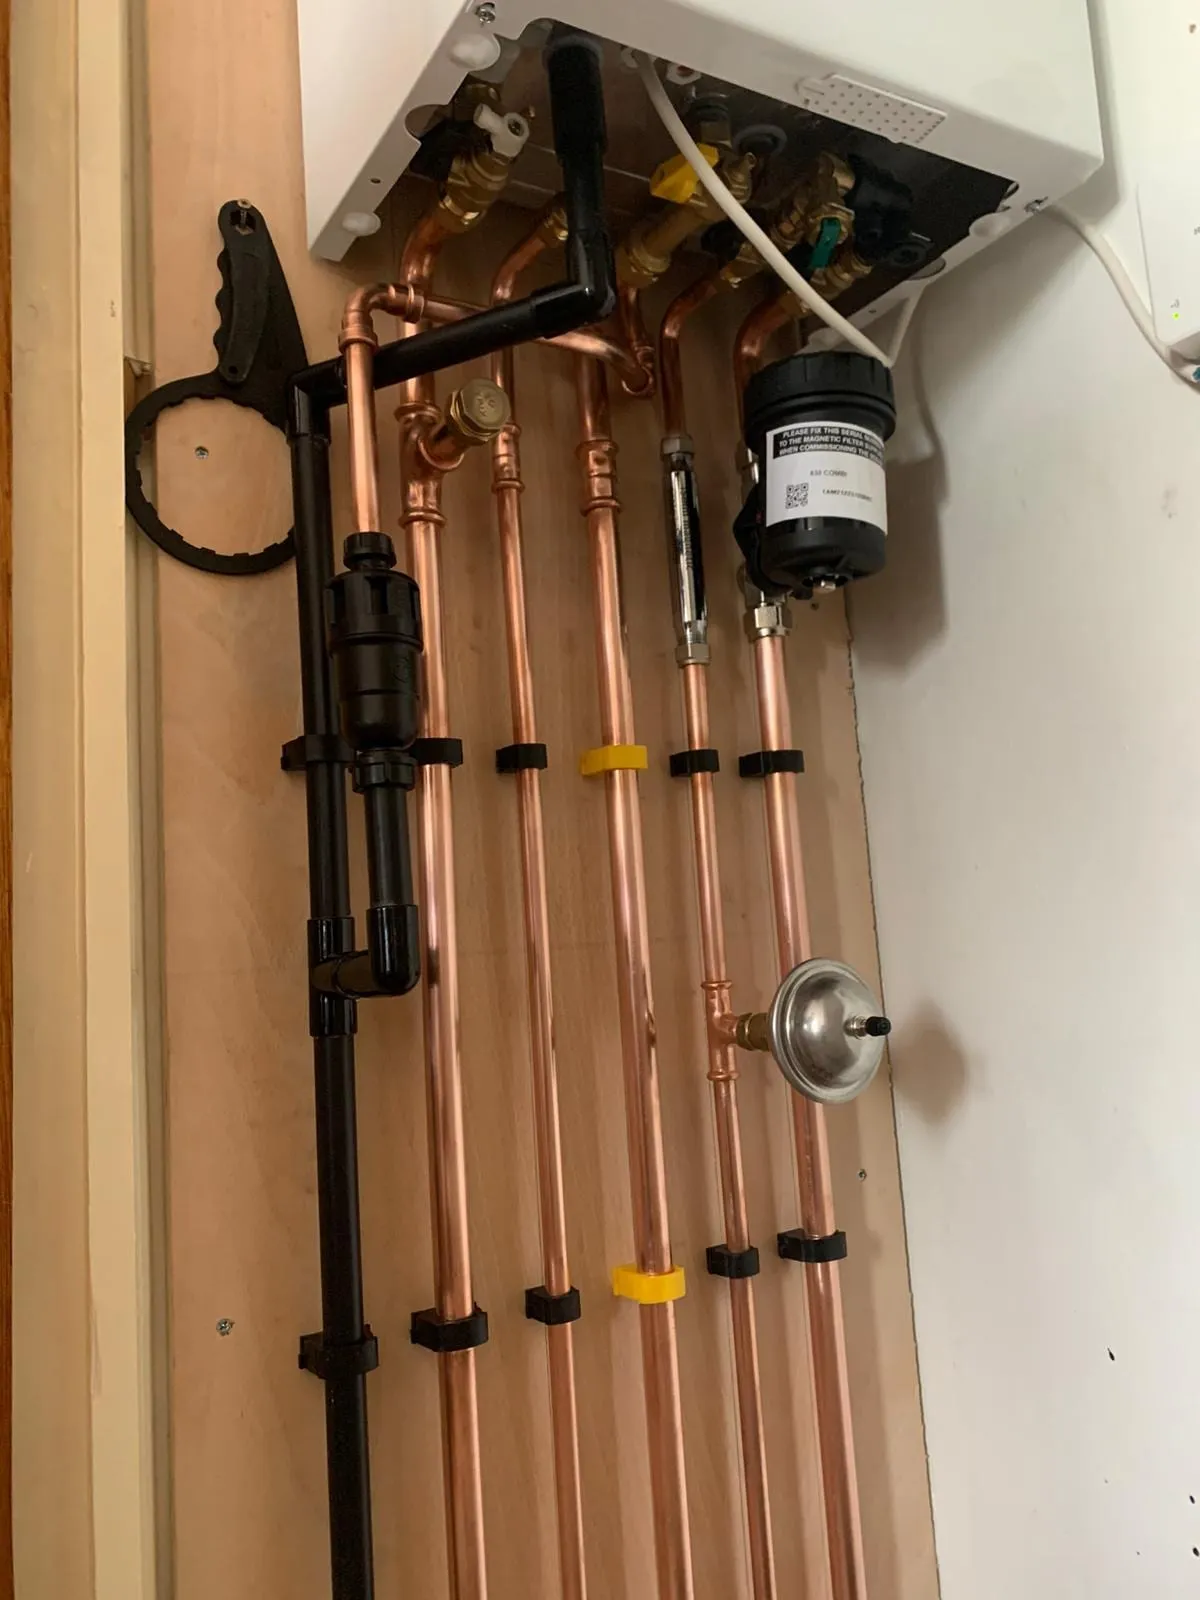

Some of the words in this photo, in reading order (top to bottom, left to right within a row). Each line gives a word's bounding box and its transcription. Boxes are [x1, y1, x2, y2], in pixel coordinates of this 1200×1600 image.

[783, 428, 808, 438] PLEASE
[824, 427, 839, 435] THIS
[841, 428, 863, 439] SERIAL
[779, 439, 788, 447] TO
[789, 437, 801, 445] THE
[803, 435, 841, 443] MAGNETIC
[842, 437, 864, 447] FILTER
[779, 447, 798, 455] WHEN
[799, 443, 857, 453] COMMISSIONING
